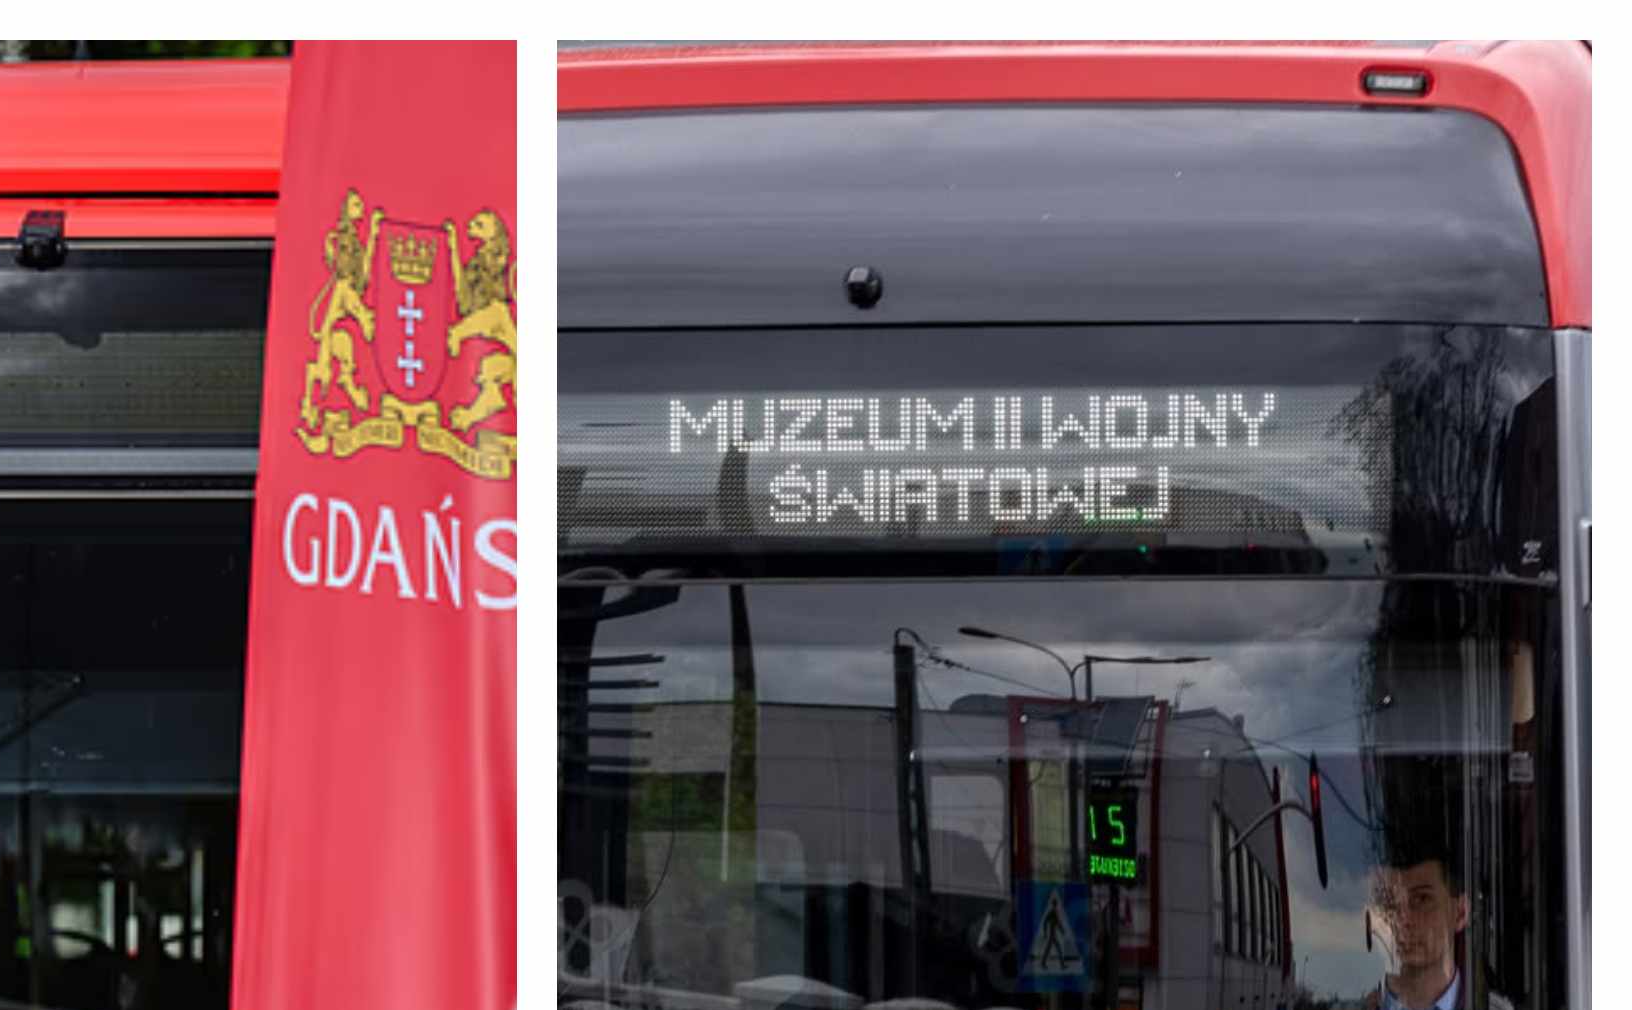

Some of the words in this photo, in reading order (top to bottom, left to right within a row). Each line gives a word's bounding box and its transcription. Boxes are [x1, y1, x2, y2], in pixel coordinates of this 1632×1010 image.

[669, 397, 975, 453] MUZEUM
[993, 394, 1022, 450] II
[1039, 392, 1279, 449] WOJNY
[767, 464, 1169, 523] ŚWIATOWEJ
[283, 493, 517, 610] GDAŃS
